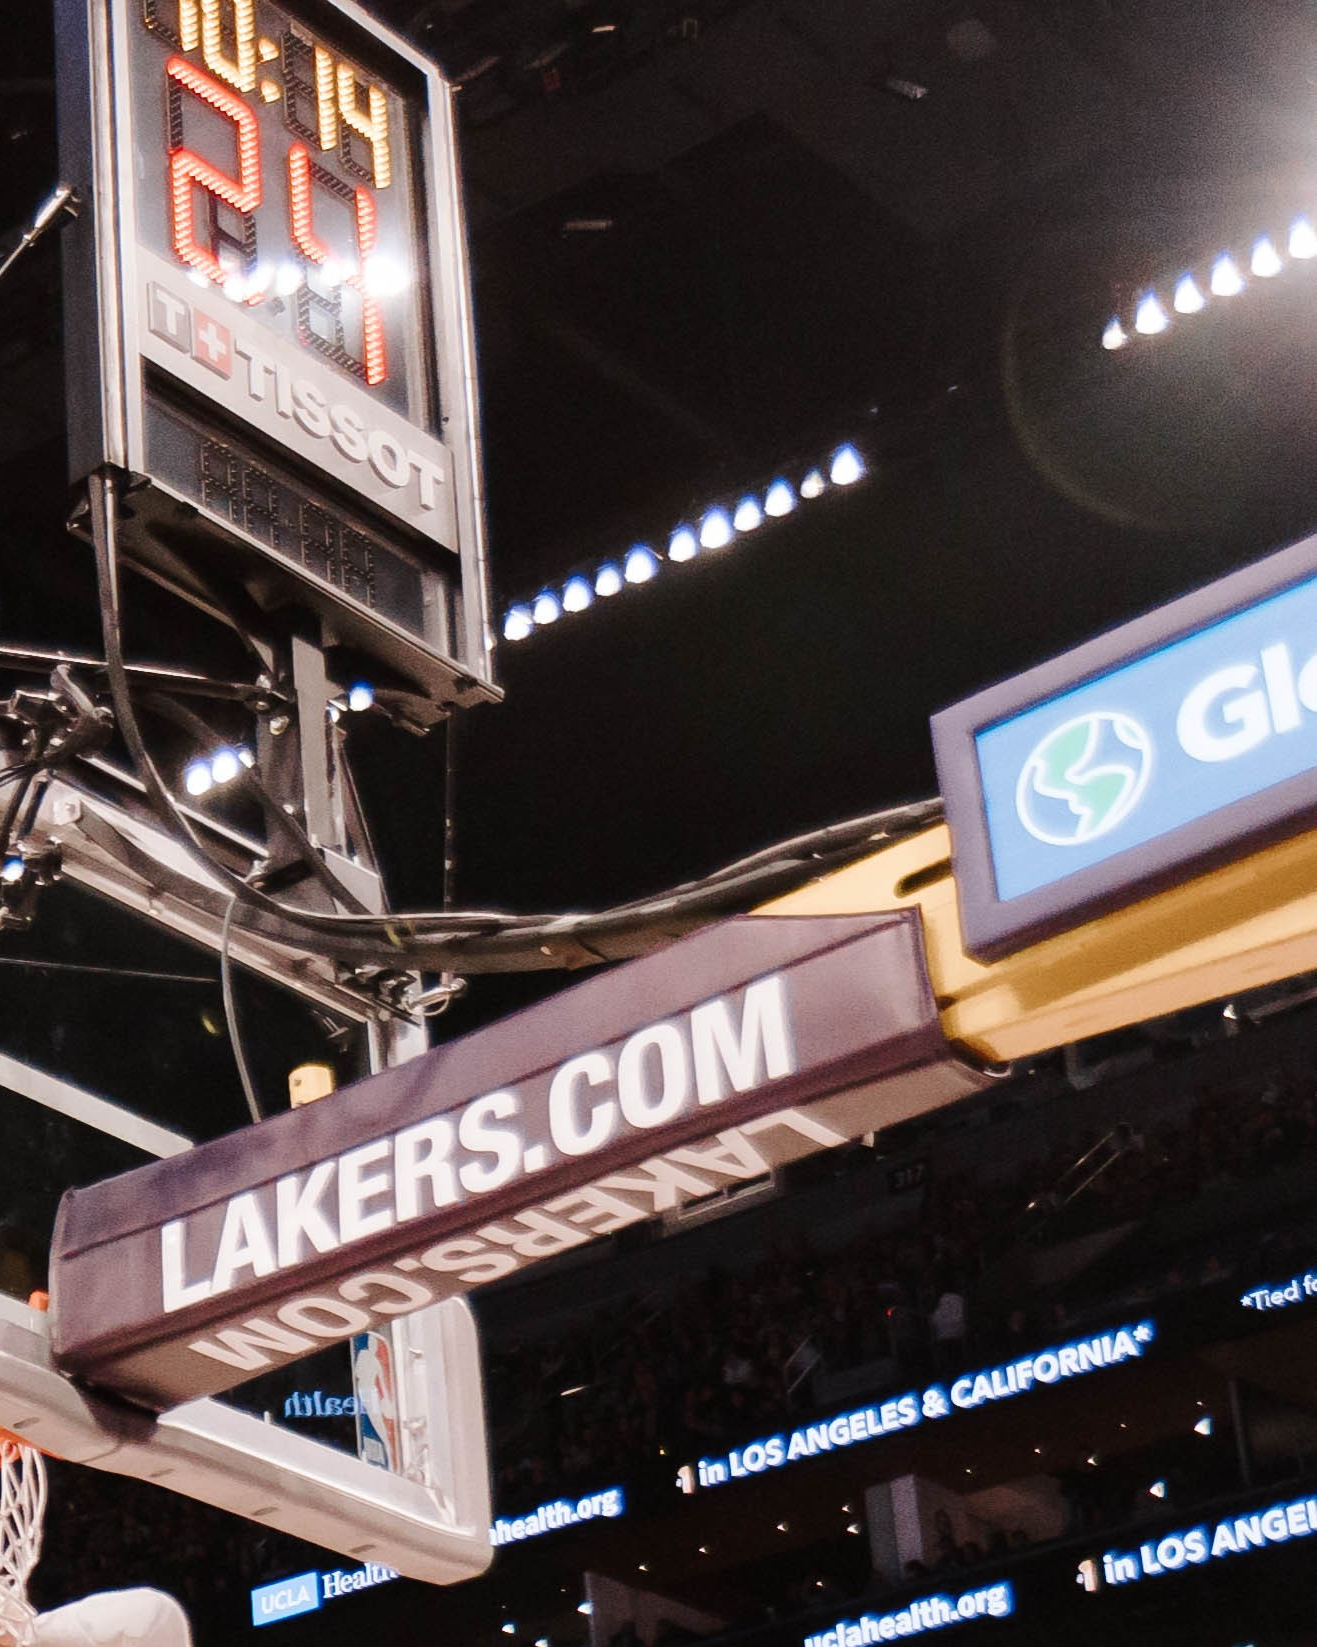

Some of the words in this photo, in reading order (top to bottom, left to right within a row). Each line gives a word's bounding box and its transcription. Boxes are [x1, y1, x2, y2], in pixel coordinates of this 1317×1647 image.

[234, 337, 445, 511] TISSOT
[160, 974, 794, 1314] LAKERS.COM
[698, 1456, 727, 1488] in
[729, 1437, 784, 1478] LOS
[786, 1396, 920, 1460] ANGELES
[921, 1385, 950, 1419] &
[260, 1586, 311, 1616] UCLA
[1103, 1554, 1138, 1585] in
[1140, 1530, 1209, 1575] LOS
